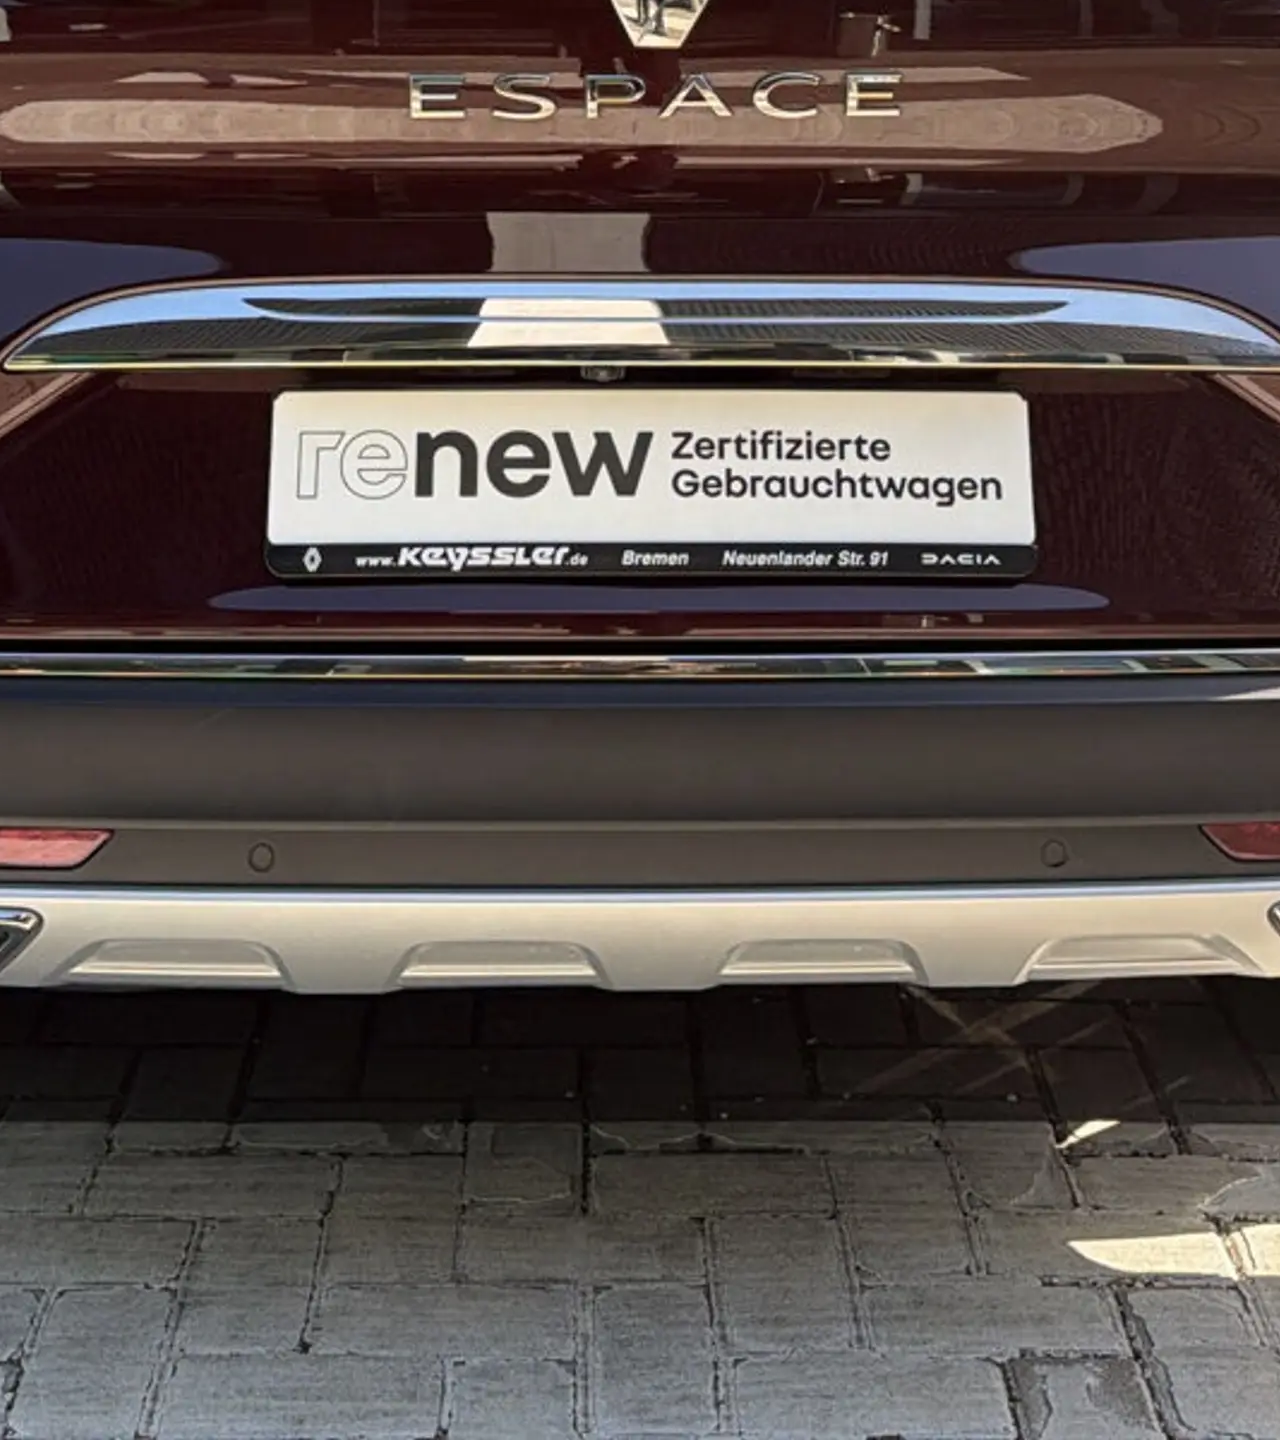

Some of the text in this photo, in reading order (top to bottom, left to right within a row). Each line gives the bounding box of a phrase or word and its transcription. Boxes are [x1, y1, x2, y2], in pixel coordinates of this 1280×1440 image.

[408, 71, 904, 121] ESPACE
[296, 429, 655, 501] renew
[671, 430, 892, 461] Zertifizierte
[671, 467, 1003, 508] Gebrauchtwagen
[621, 548, 690, 566] Bremen
[722, 548, 834, 567] Neuenlander
[837, 549, 866, 567] Str.
[869, 549, 889, 567] 91
[921, 552, 1001, 566] DACIA
